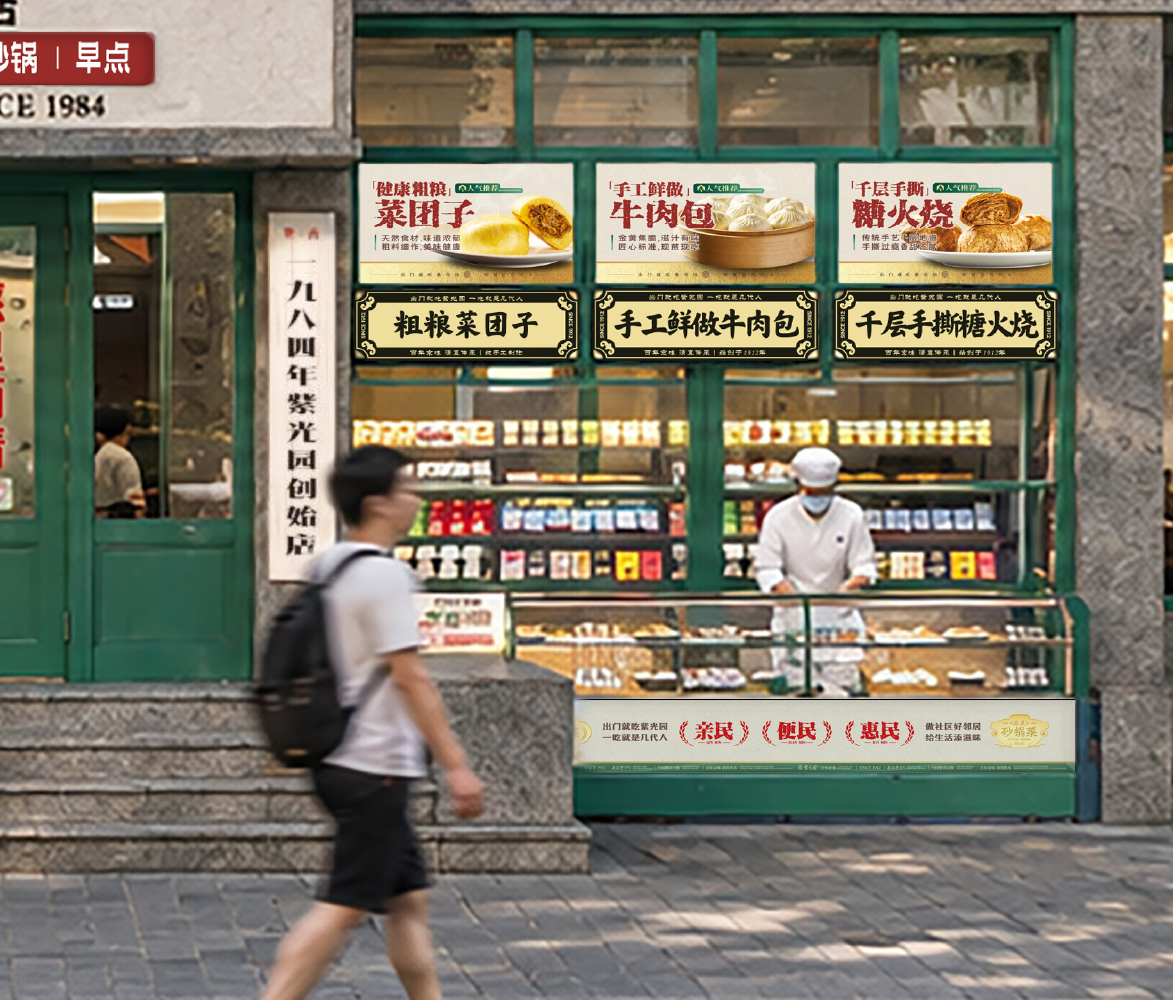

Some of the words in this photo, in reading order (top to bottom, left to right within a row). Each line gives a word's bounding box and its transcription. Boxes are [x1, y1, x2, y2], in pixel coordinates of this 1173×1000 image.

[76, 42, 130, 73] 早点
[48, 94, 105, 118] 1984
[374, 199, 475, 228] 菜团子
[610, 199, 715, 229] 牛肉包
[852, 199, 954, 228] 糖火烧
[394, 310, 538, 339] 粗粮菜团子
[614, 309, 799, 339] 手工鲜做牛肉包
[856, 308, 1040, 339] 千层手撕糖火烧
[694, 722, 733, 740] 亲民
[777, 722, 816, 740] 便民
[860, 721, 899, 740] 惠民
